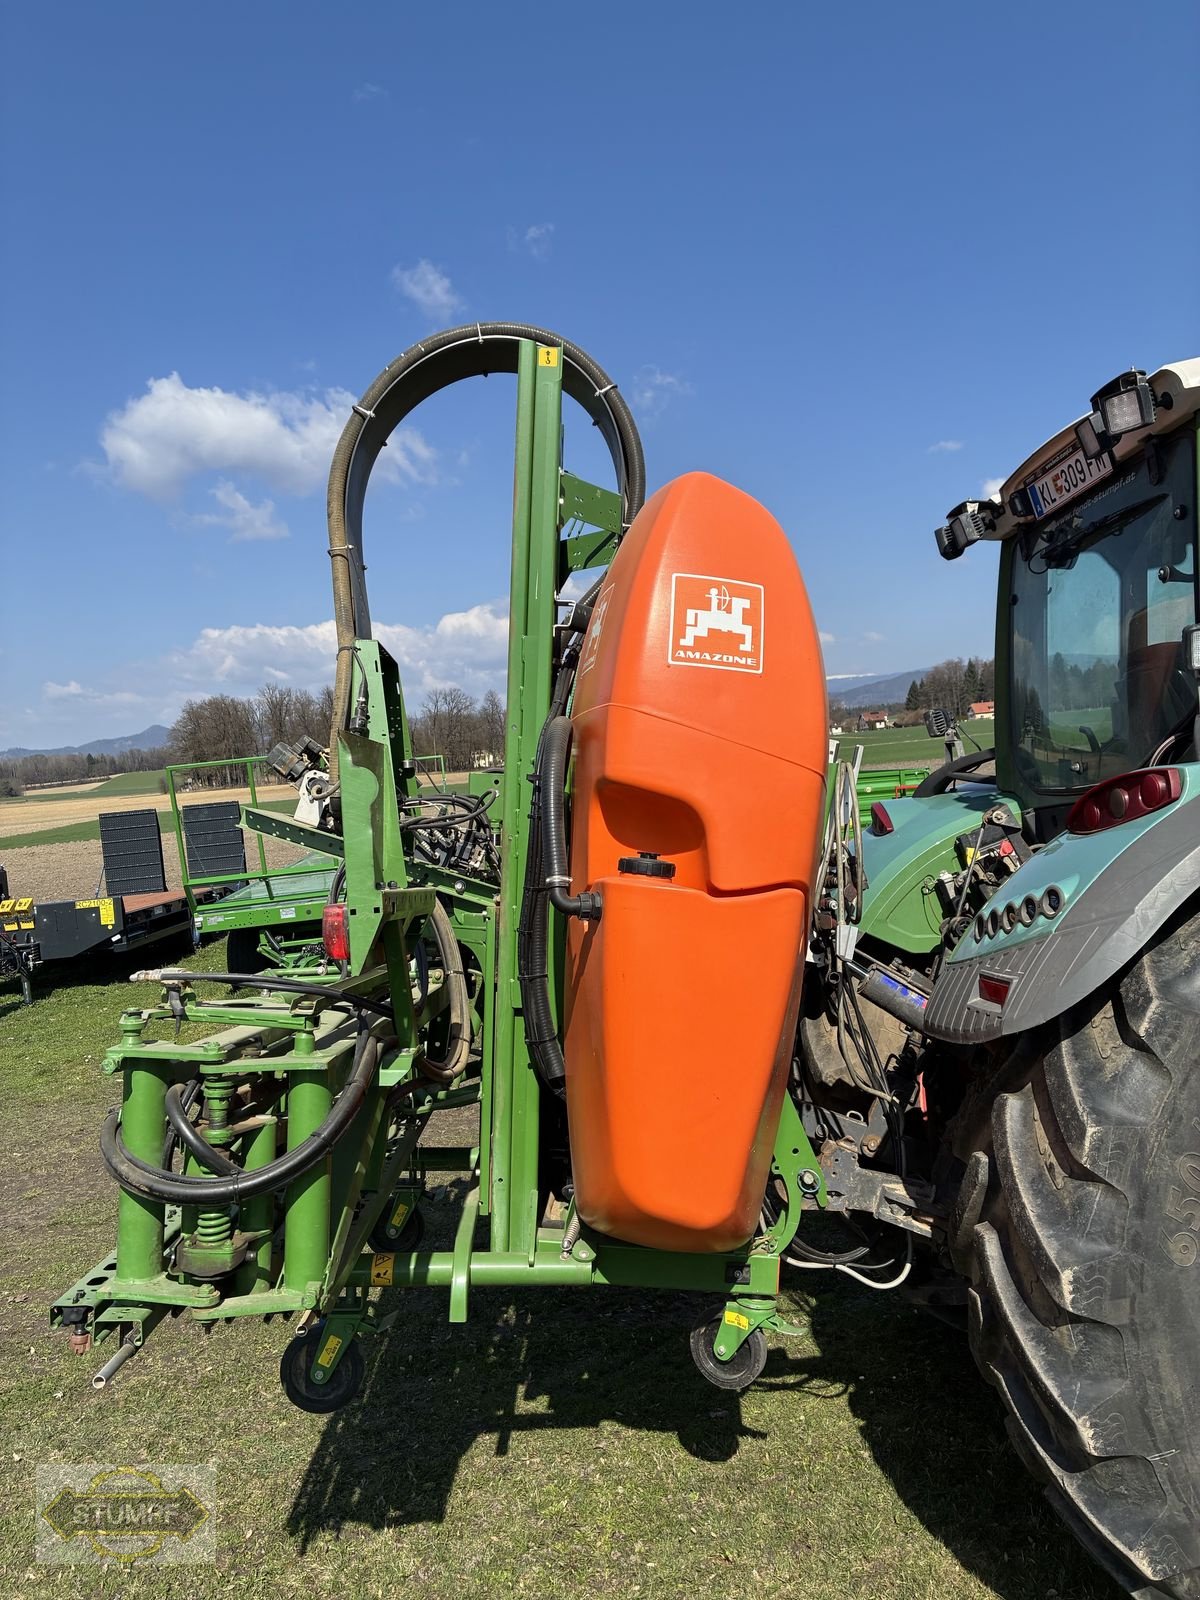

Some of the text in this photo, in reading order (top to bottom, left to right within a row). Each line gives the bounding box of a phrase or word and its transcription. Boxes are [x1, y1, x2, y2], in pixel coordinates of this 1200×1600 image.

[1038, 481, 1056, 508] KL
[1060, 458, 1086, 493] 309
[674, 650, 757, 666] AMAZONE
